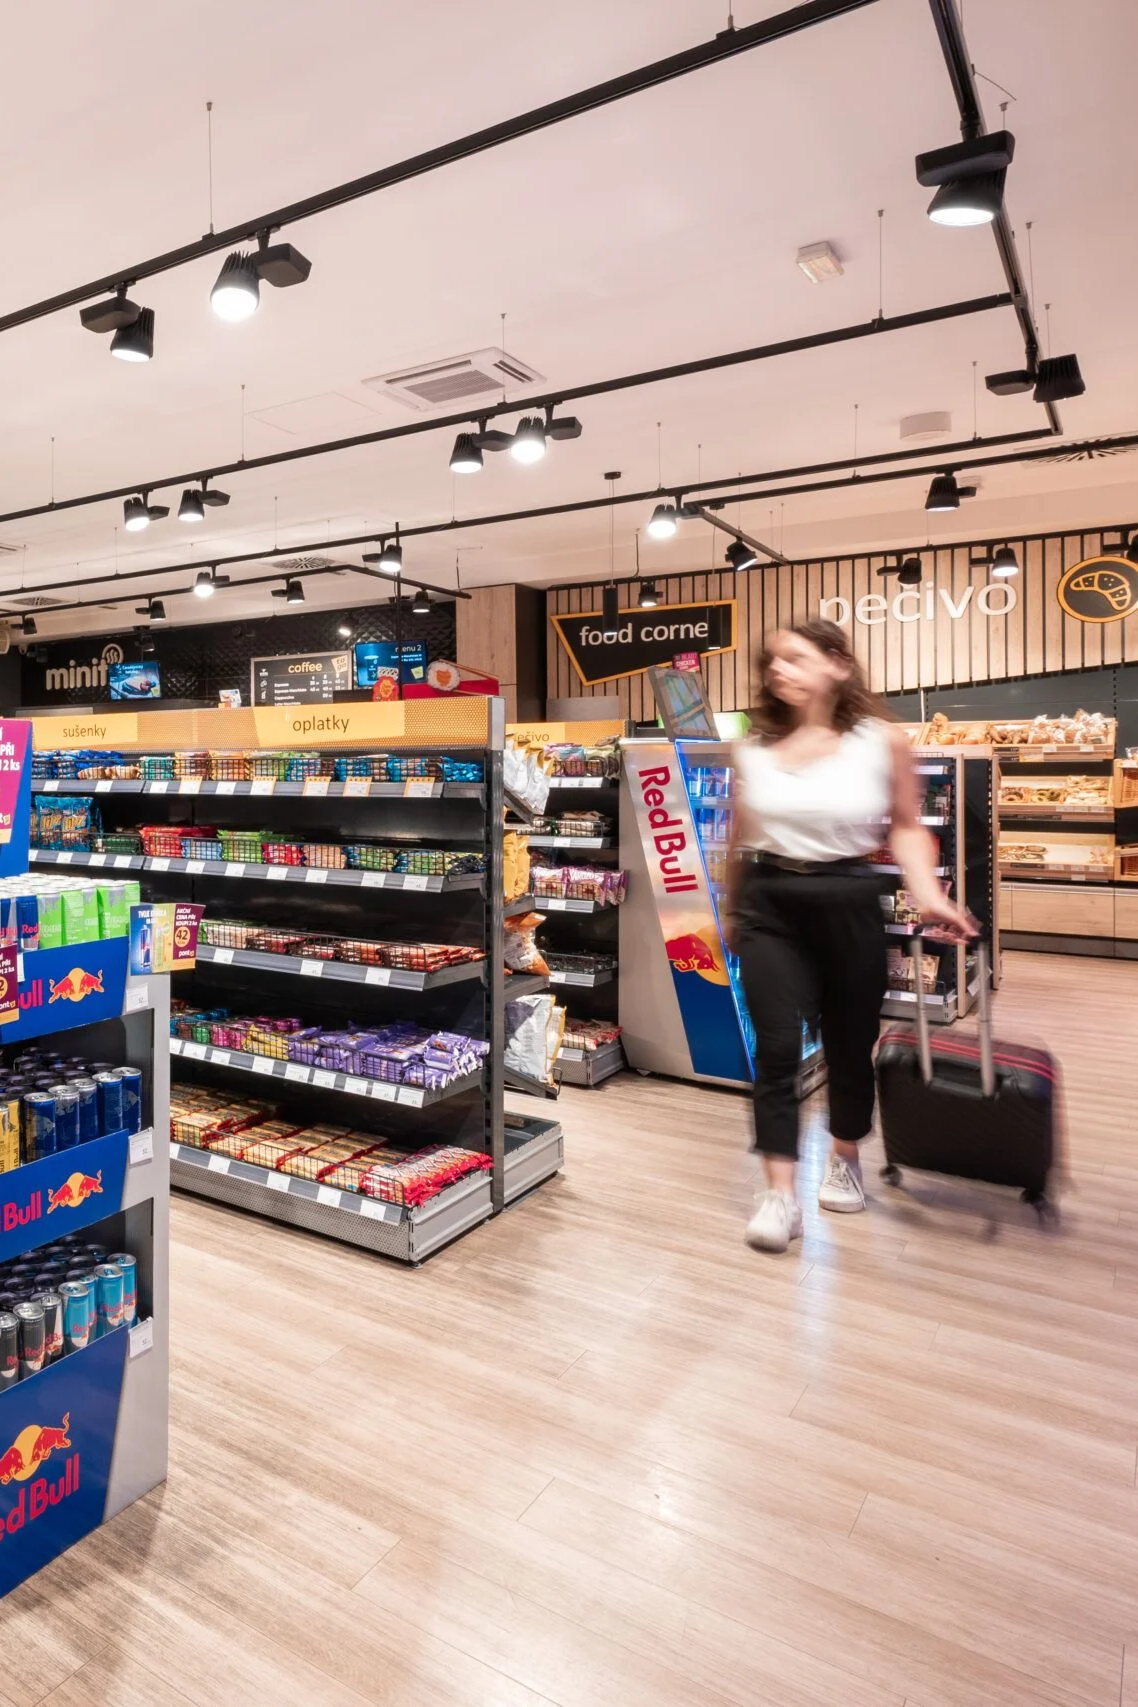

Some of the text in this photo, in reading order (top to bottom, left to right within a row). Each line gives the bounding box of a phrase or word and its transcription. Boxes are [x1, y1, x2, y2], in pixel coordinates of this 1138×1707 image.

[579, 622, 709, 646] food corne
[46, 657, 108, 690] minit
[288, 661, 323, 673] coffee
[62, 724, 107, 739] sušenky
[292, 715, 349, 734] oplatky
[517, 731, 550, 742] ečivo
[0, 742, 15, 756] PŘI
[2, 759, 9, 771] 2
[10, 758, 20, 771] ks
[638, 765, 699, 894] Red Bull
[22, 924, 38, 934] Red
[176, 929, 188, 940] 42
[18, 979, 43, 1010] ull
[3, 1190, 42, 1231] Bull
[29, 1453, 80, 1521] Bull
